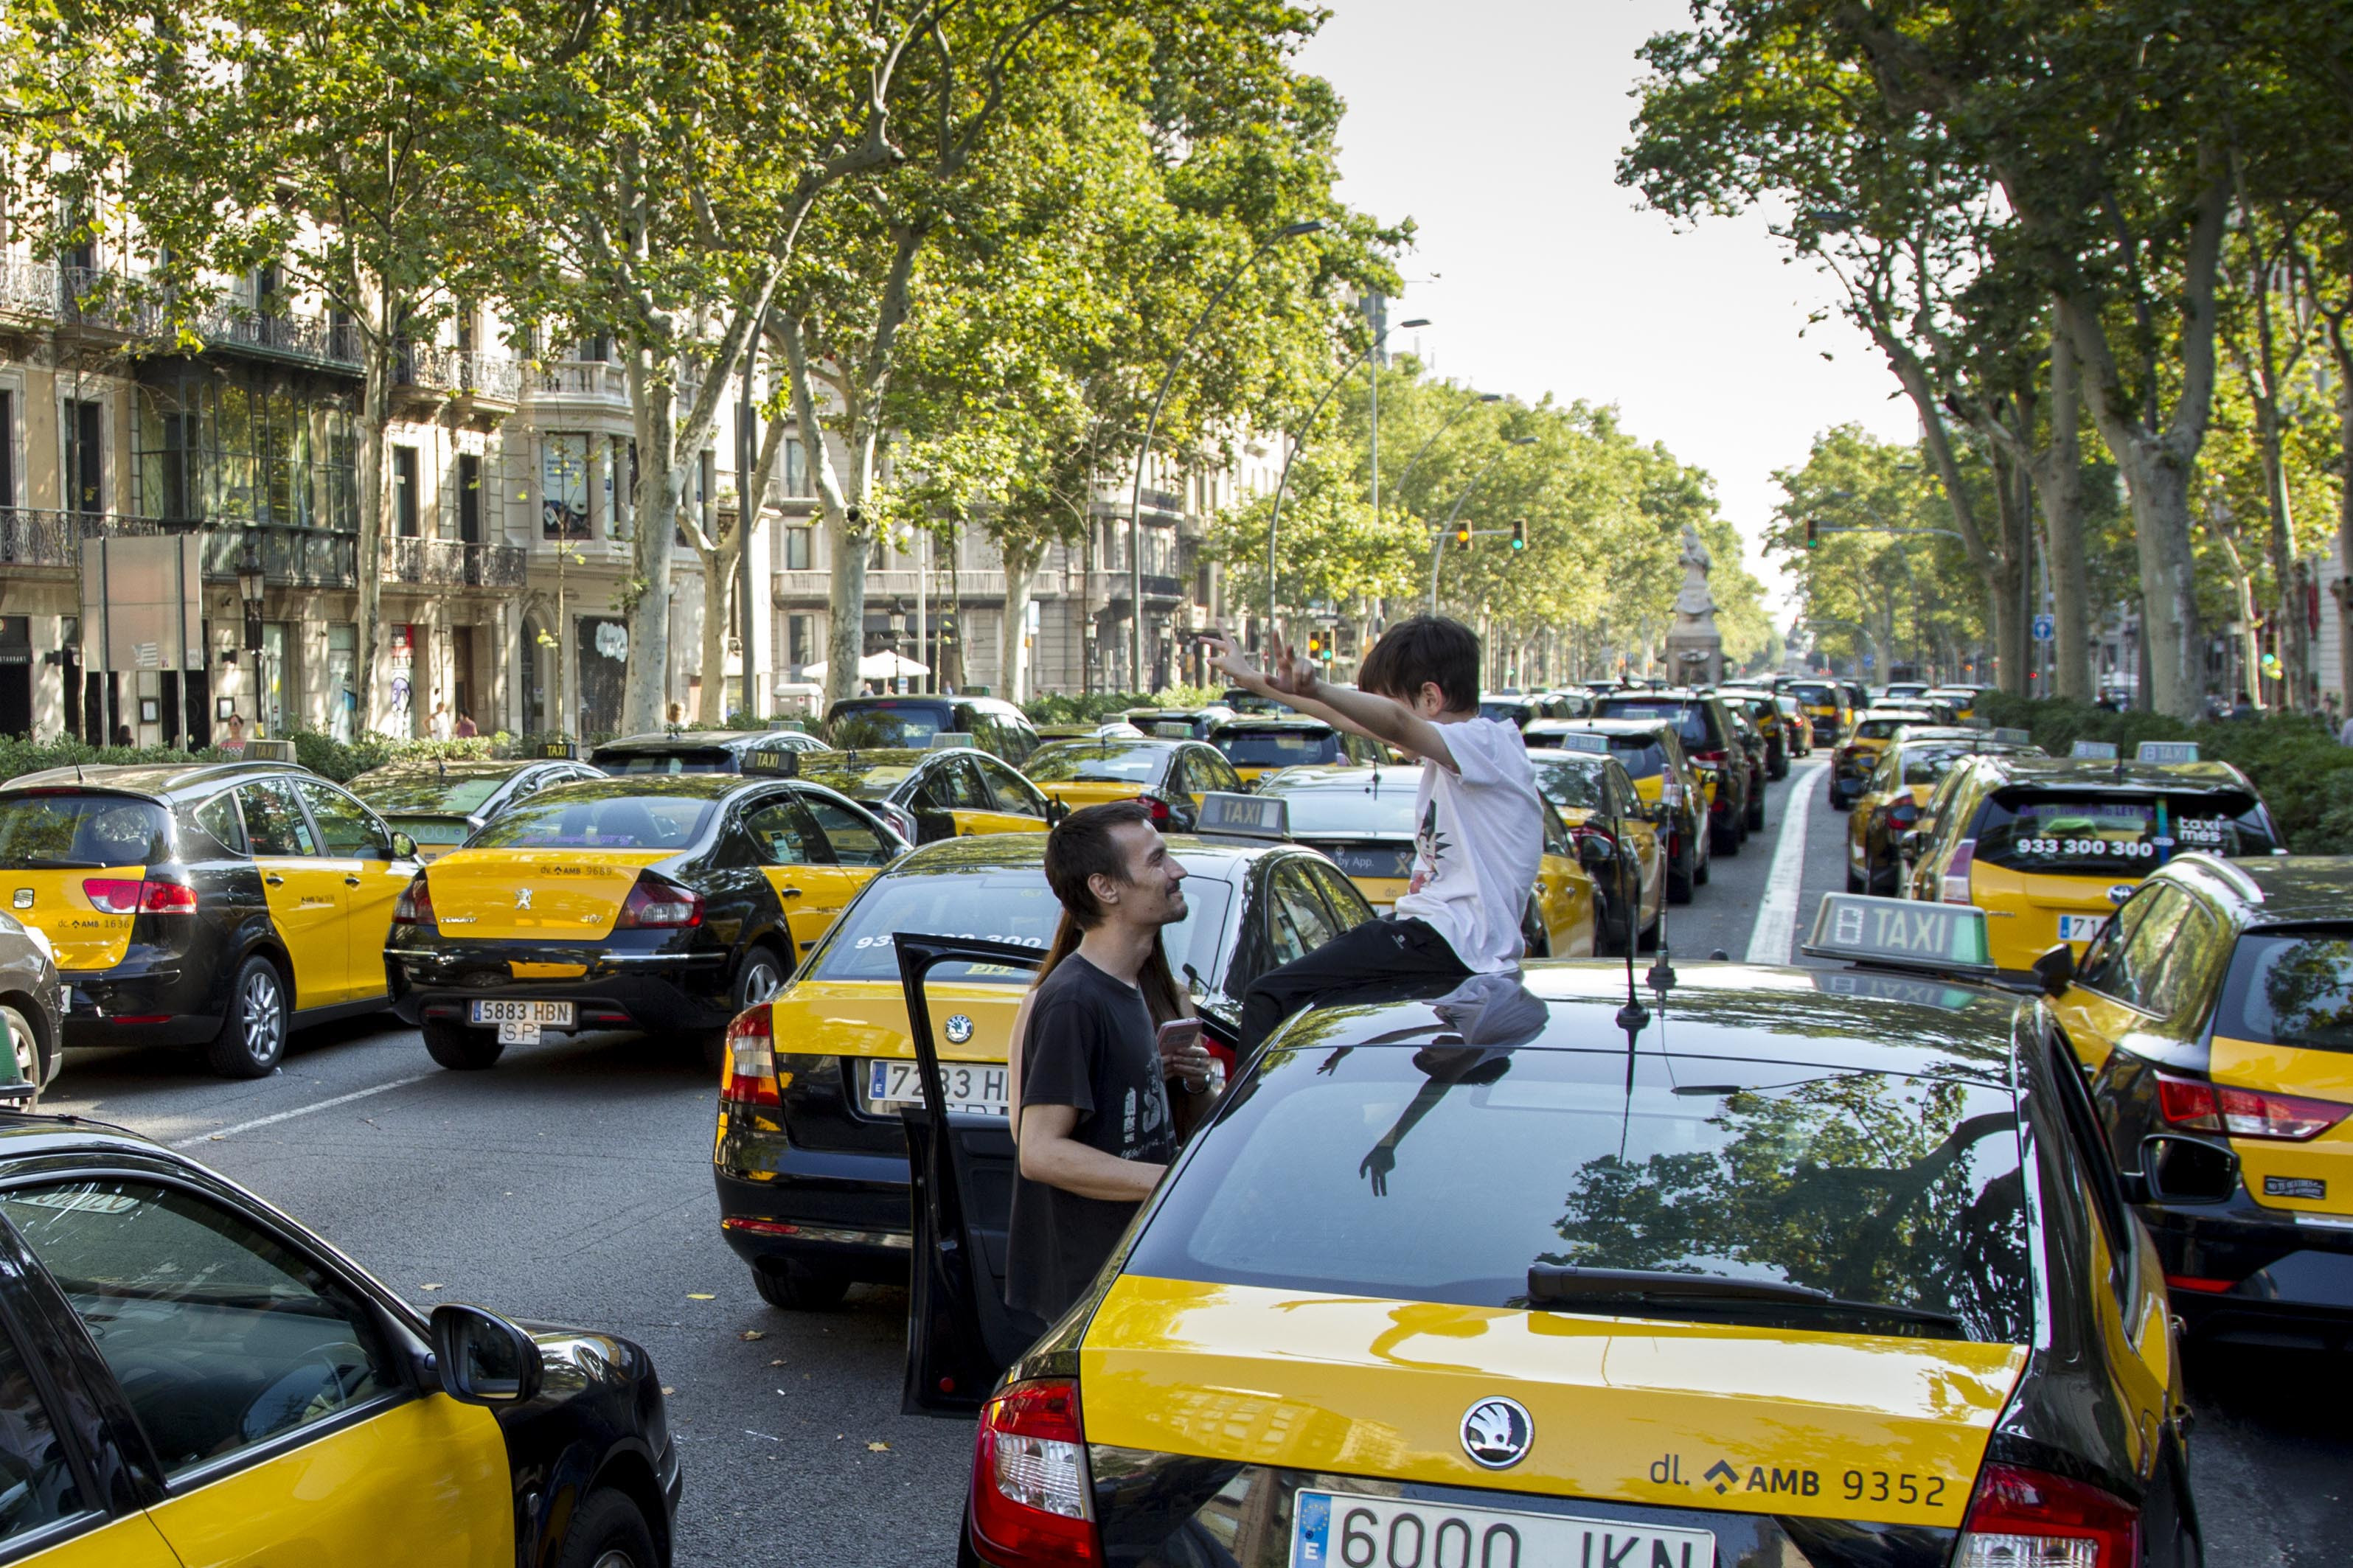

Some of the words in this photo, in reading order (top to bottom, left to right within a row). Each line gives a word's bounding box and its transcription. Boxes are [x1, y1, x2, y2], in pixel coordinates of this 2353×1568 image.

[256, 744, 278, 759] TAXI
[546, 745, 567, 757] TAXI
[2159, 746, 2189, 762] TAXI
[757, 753, 779, 768] TAXI
[1224, 800, 1262, 826] TAXI
[2178, 814, 2225, 831] taxi
[2017, 839, 2060, 853] 933
[2064, 840, 2107, 854] 300
[2110, 841, 2154, 857] 300
[586, 866, 612, 875] 9689
[1338, 857, 1349, 868] by
[1352, 857, 1374, 869] App.
[104, 920, 130, 929] 1636
[1873, 907, 1947, 952] TAXI
[484, 1003, 526, 1020] 5883
[534, 1003, 568, 1022] HBN
[1650, 1453, 1691, 1486] dl.
[1745, 1466, 1821, 1496] AMB
[1843, 1470, 1946, 1507] 9352
[1304, 1542, 1320, 1561] E
[1341, 1508, 1521, 1568] 6000
